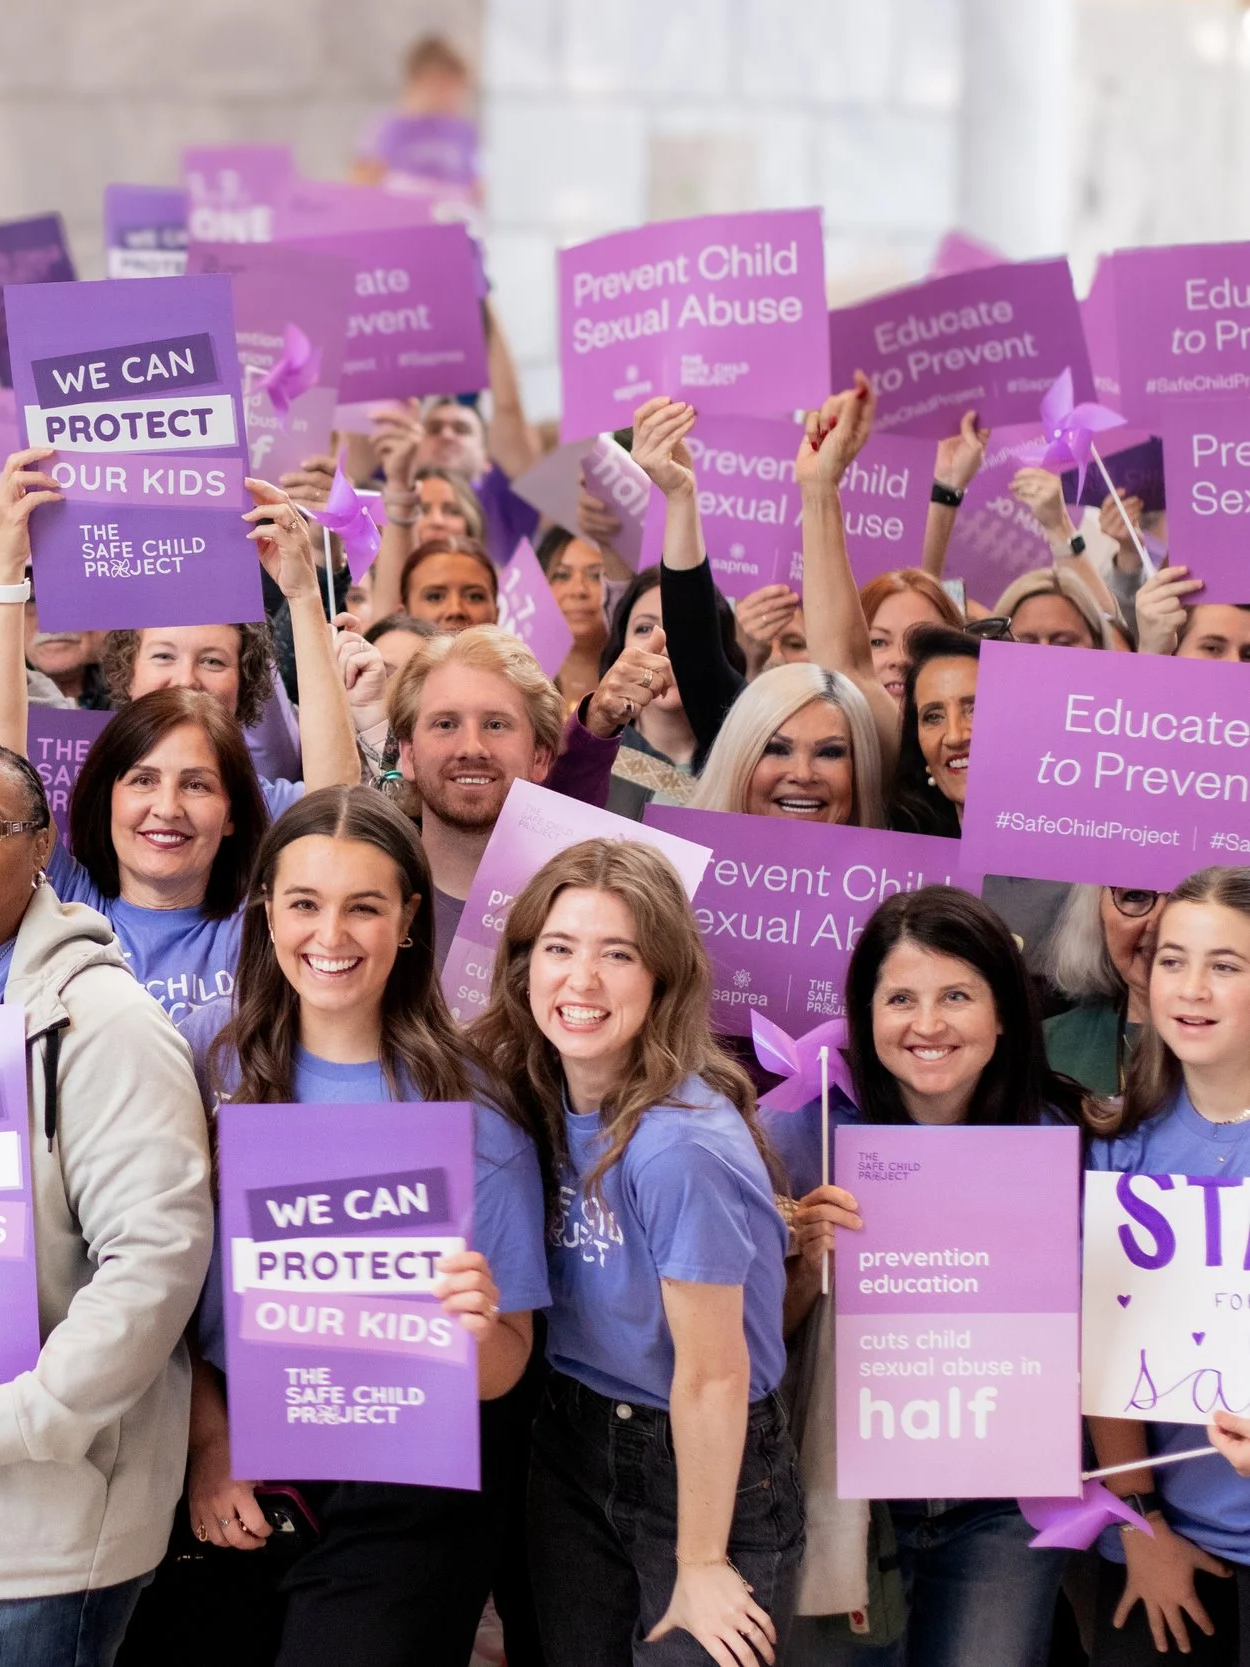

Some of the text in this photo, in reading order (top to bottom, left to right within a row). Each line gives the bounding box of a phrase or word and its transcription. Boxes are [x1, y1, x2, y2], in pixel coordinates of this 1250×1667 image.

[572, 240, 798, 308] Prevent Child
[572, 292, 803, 353] Sexual Abuse
[874, 300, 1014, 355] Educate
[1171, 326, 1207, 355] to
[52, 348, 195, 395] WE CAN
[907, 331, 1040, 383] Prevent
[45, 407, 214, 443] PROTECT
[50, 462, 226, 497] OUR KIDS
[838, 460, 909, 500] hild
[79, 524, 120, 541] THE
[82, 537, 206, 560] SAFE CHILD
[1064, 693, 1250, 748] Educate
[37, 737, 91, 762] THE
[1037, 750, 1082, 787] to
[995, 810, 1180, 847] #SafeChildProject
[711, 988, 769, 1007] saprea
[807, 990, 839, 1004] SAFE
[809, 979, 834, 992] THE
[858, 1152, 879, 1161] THE
[858, 1161, 922, 1172] SAFE CHILD
[266, 1182, 430, 1229] WE CAN
[1116, 1173, 1250, 1271] ST
[257, 1250, 442, 1281] PROTECT
[858, 1248, 990, 1272] prevention
[858, 1274, 979, 1294] education
[255, 1301, 454, 1347] OUR KIDS
[858, 1329, 972, 1351] cuts child
[283, 1366, 333, 1386] THE
[858, 1356, 1042, 1378] sexual abuse in
[284, 1386, 426, 1406] SAFE CHILD
[858, 1386, 999, 1441] half
